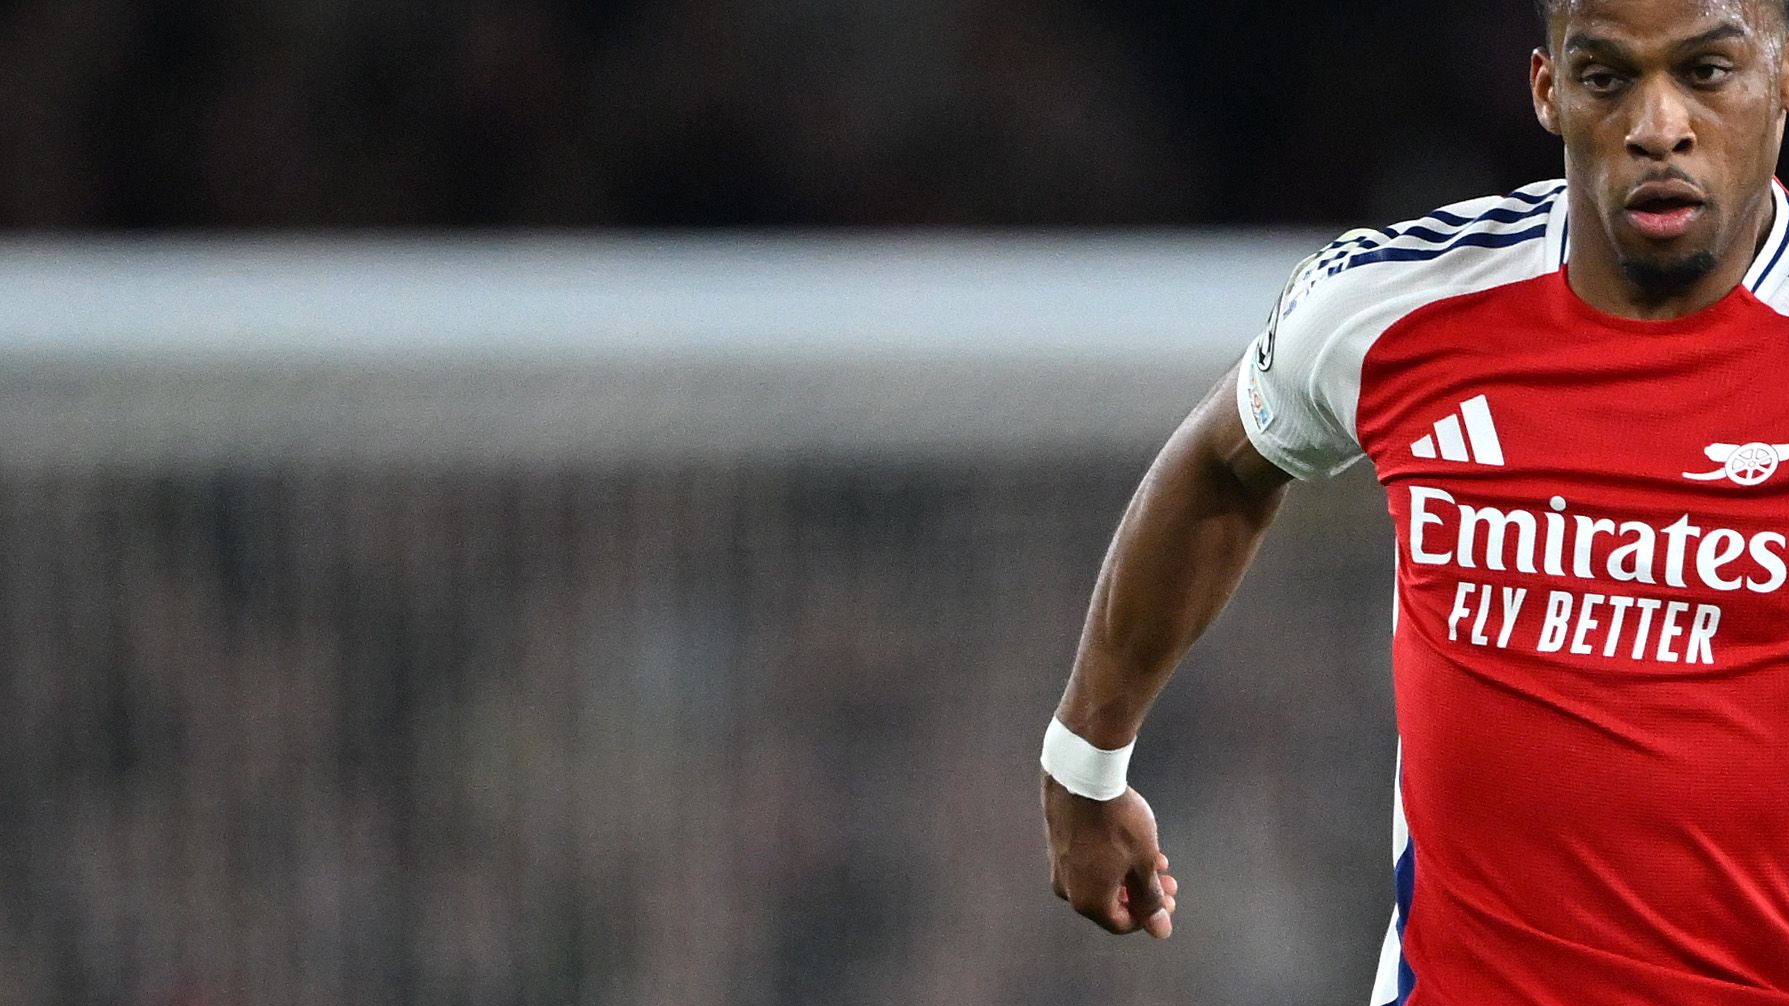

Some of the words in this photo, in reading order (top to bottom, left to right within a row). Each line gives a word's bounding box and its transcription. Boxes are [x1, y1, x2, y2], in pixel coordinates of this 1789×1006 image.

[1409, 486, 1787, 592] Emirates
[1448, 582, 1527, 648] FLY
[1537, 591, 1721, 664] BETTER
